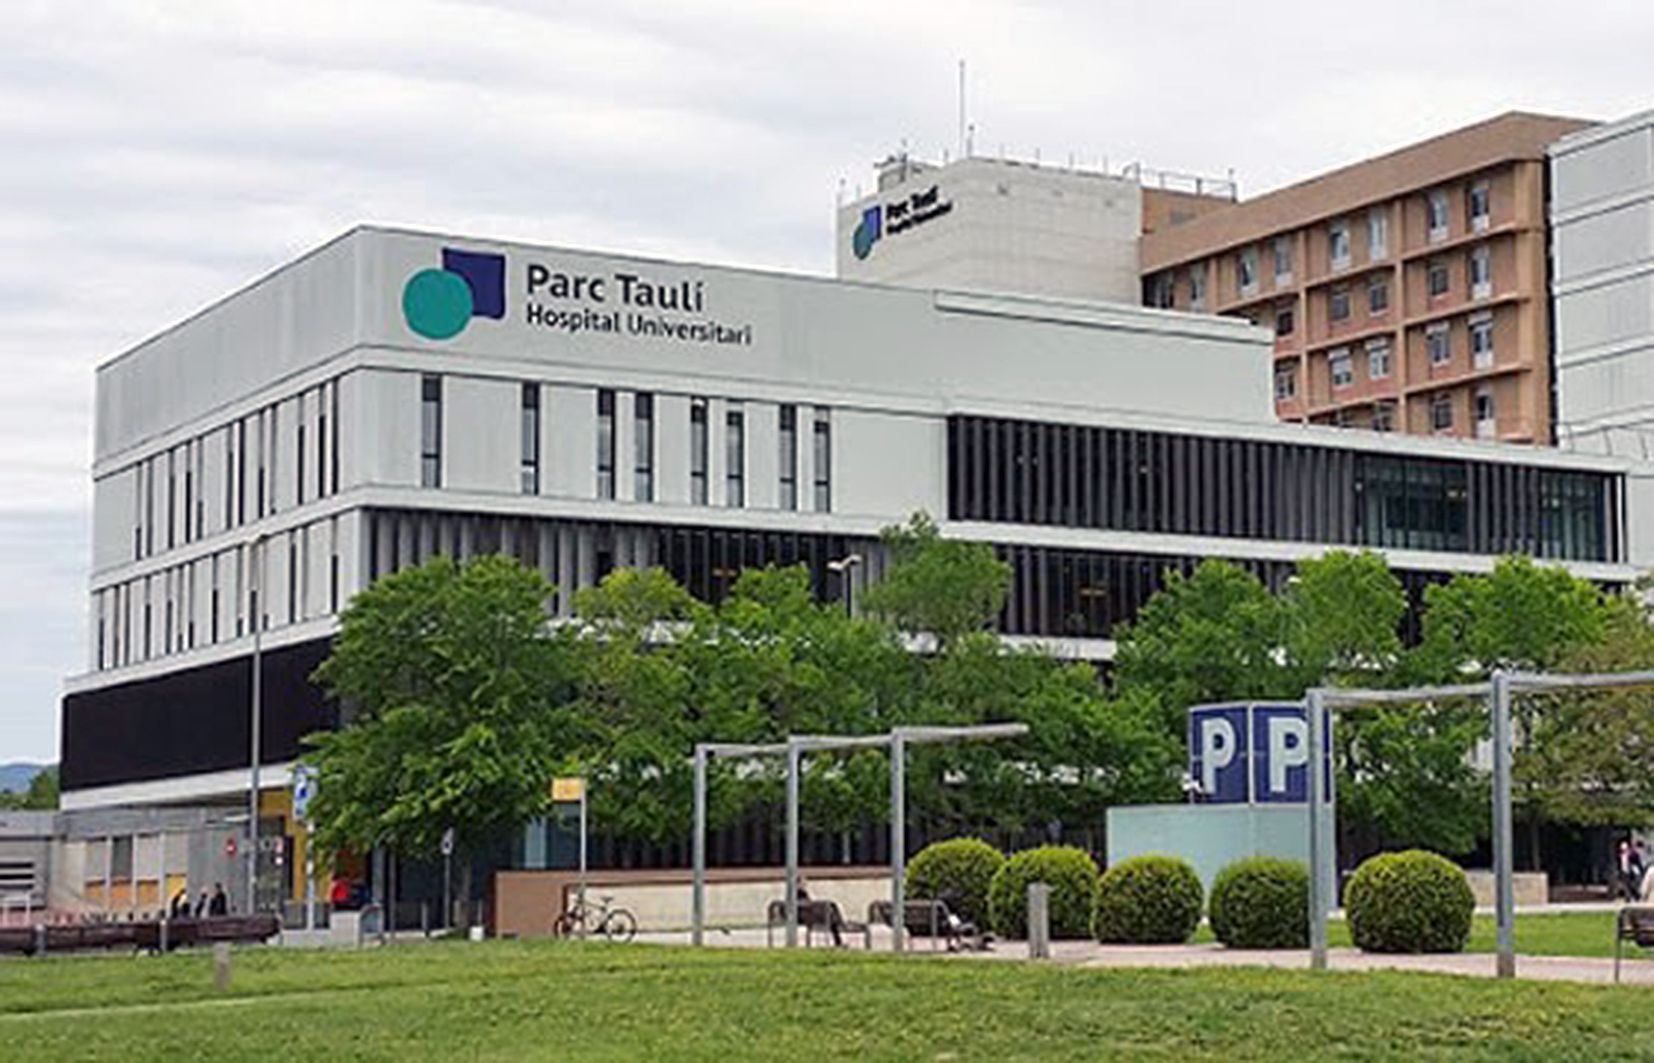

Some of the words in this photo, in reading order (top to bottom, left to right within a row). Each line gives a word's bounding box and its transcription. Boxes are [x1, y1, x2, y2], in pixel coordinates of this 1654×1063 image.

[527, 264, 606, 303] Parc
[614, 273, 704, 312] Taulí
[526, 303, 620, 333] Hospital
[627, 314, 752, 345] Universitari
[1202, 717, 1235, 793] P
[1269, 716, 1309, 793] P
